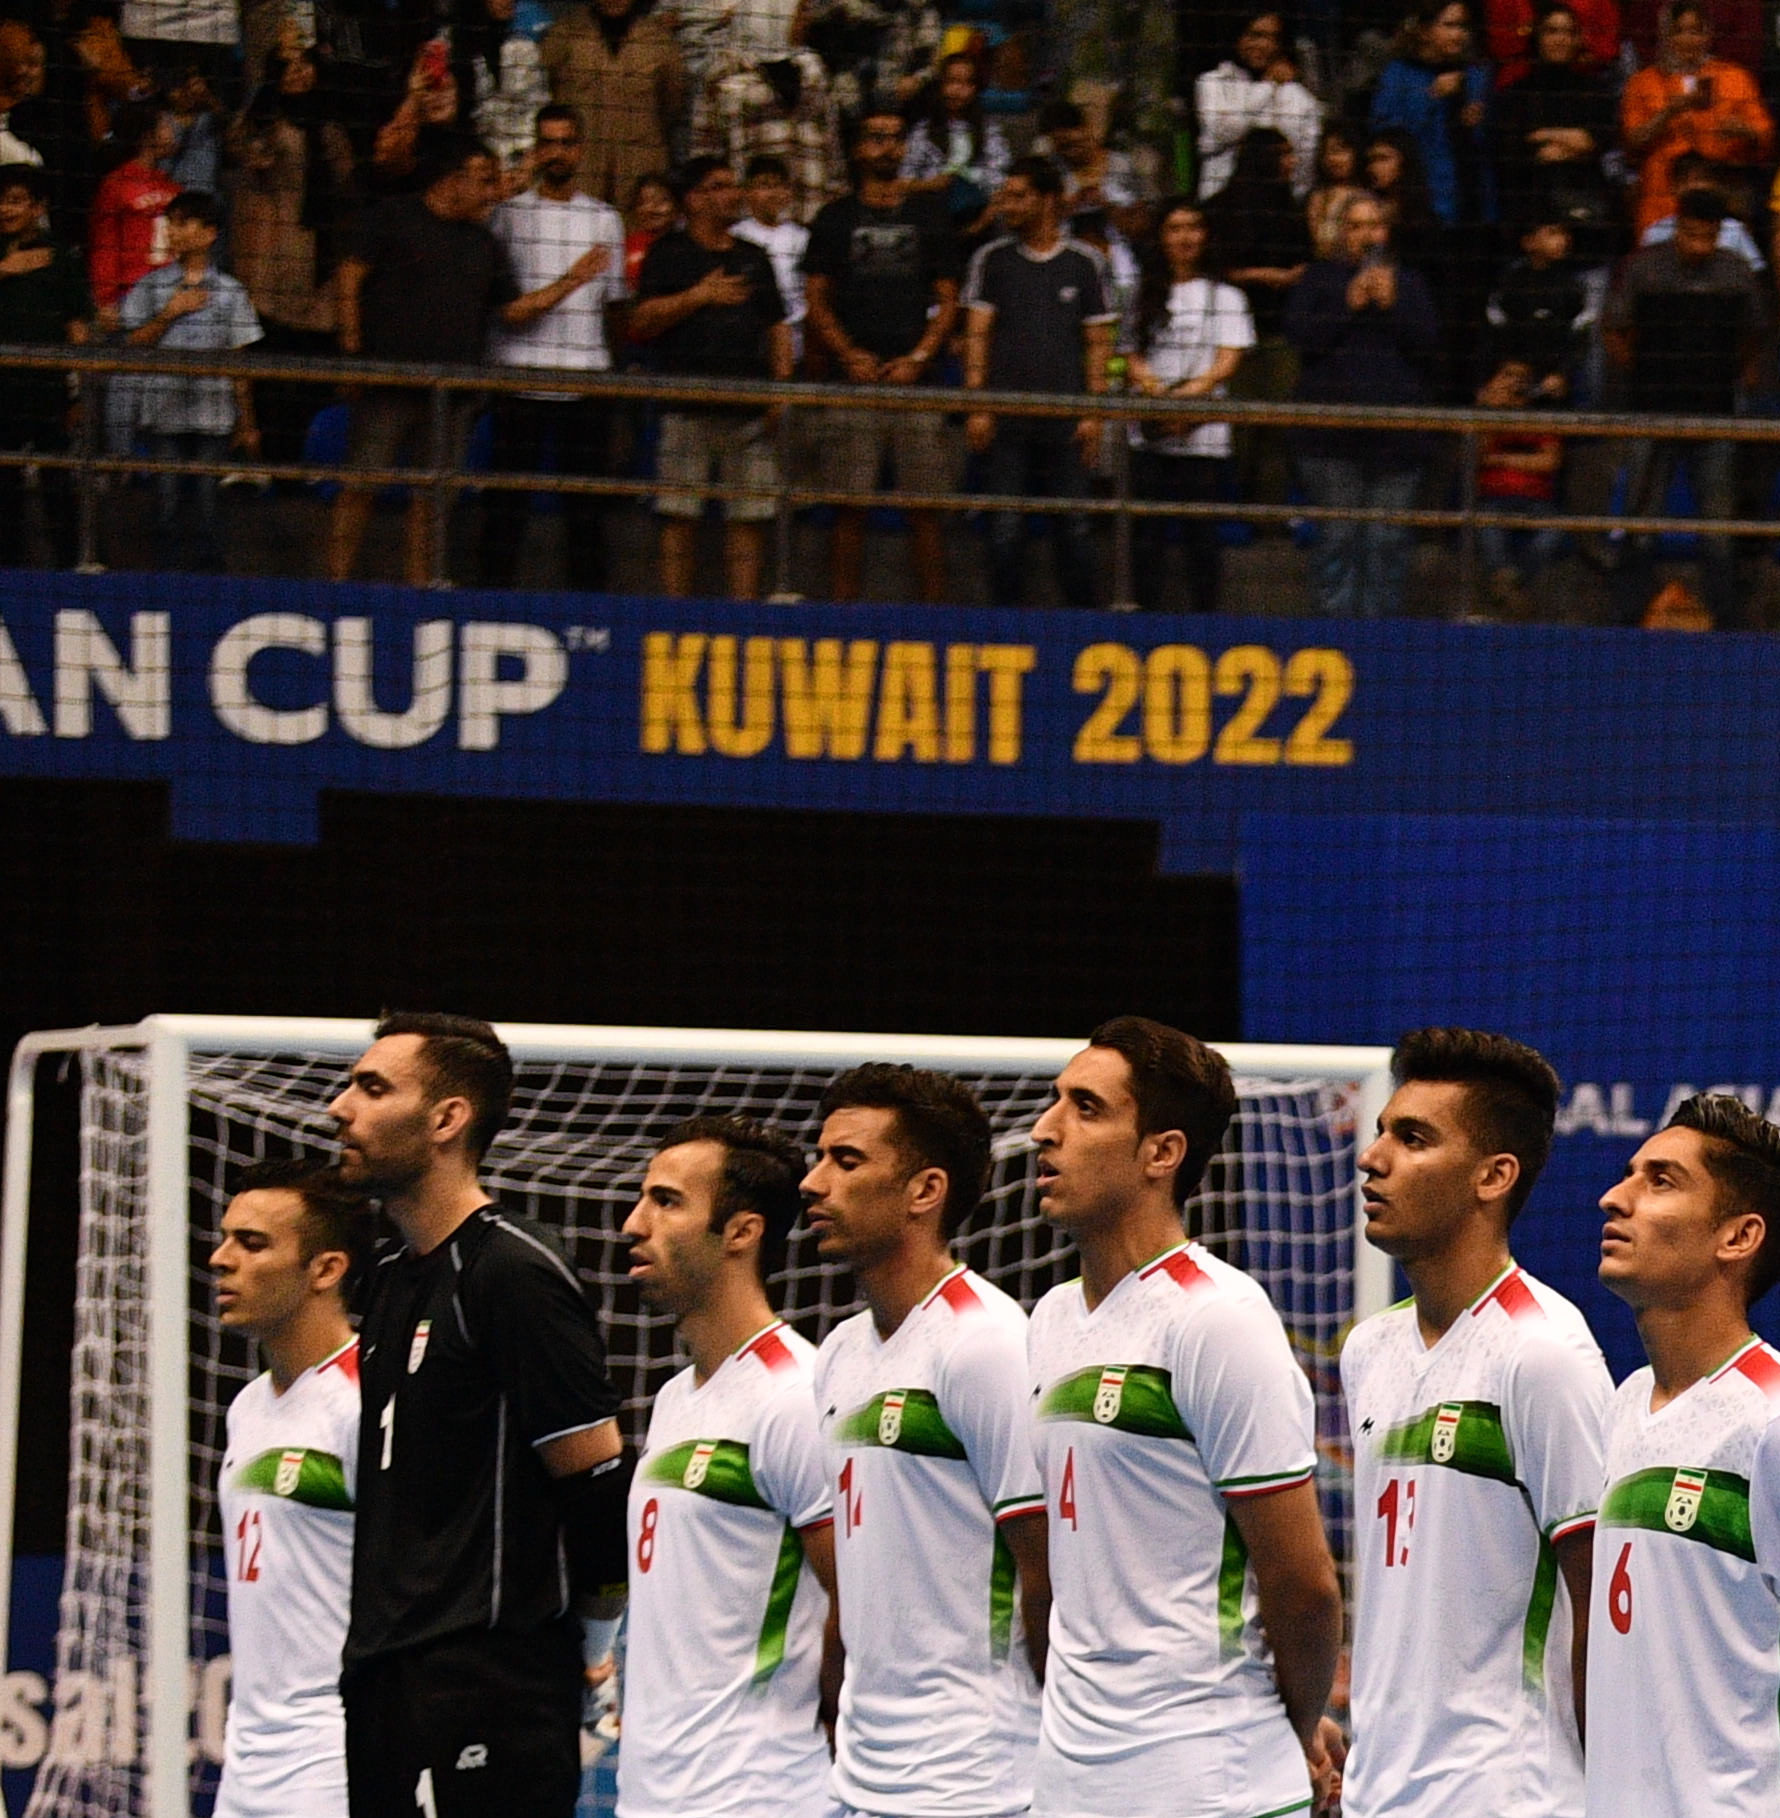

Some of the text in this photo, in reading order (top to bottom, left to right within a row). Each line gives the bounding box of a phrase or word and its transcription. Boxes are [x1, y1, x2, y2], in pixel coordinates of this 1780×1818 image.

[640, 632, 1036, 766] KUWAIT
[1070, 643, 1356, 767] 2022
[1058, 1445, 1079, 1533] 4
[235, 1507, 264, 1584] 12
[636, 1496, 659, 1575] 8
[1608, 1541, 1633, 1635] 6
